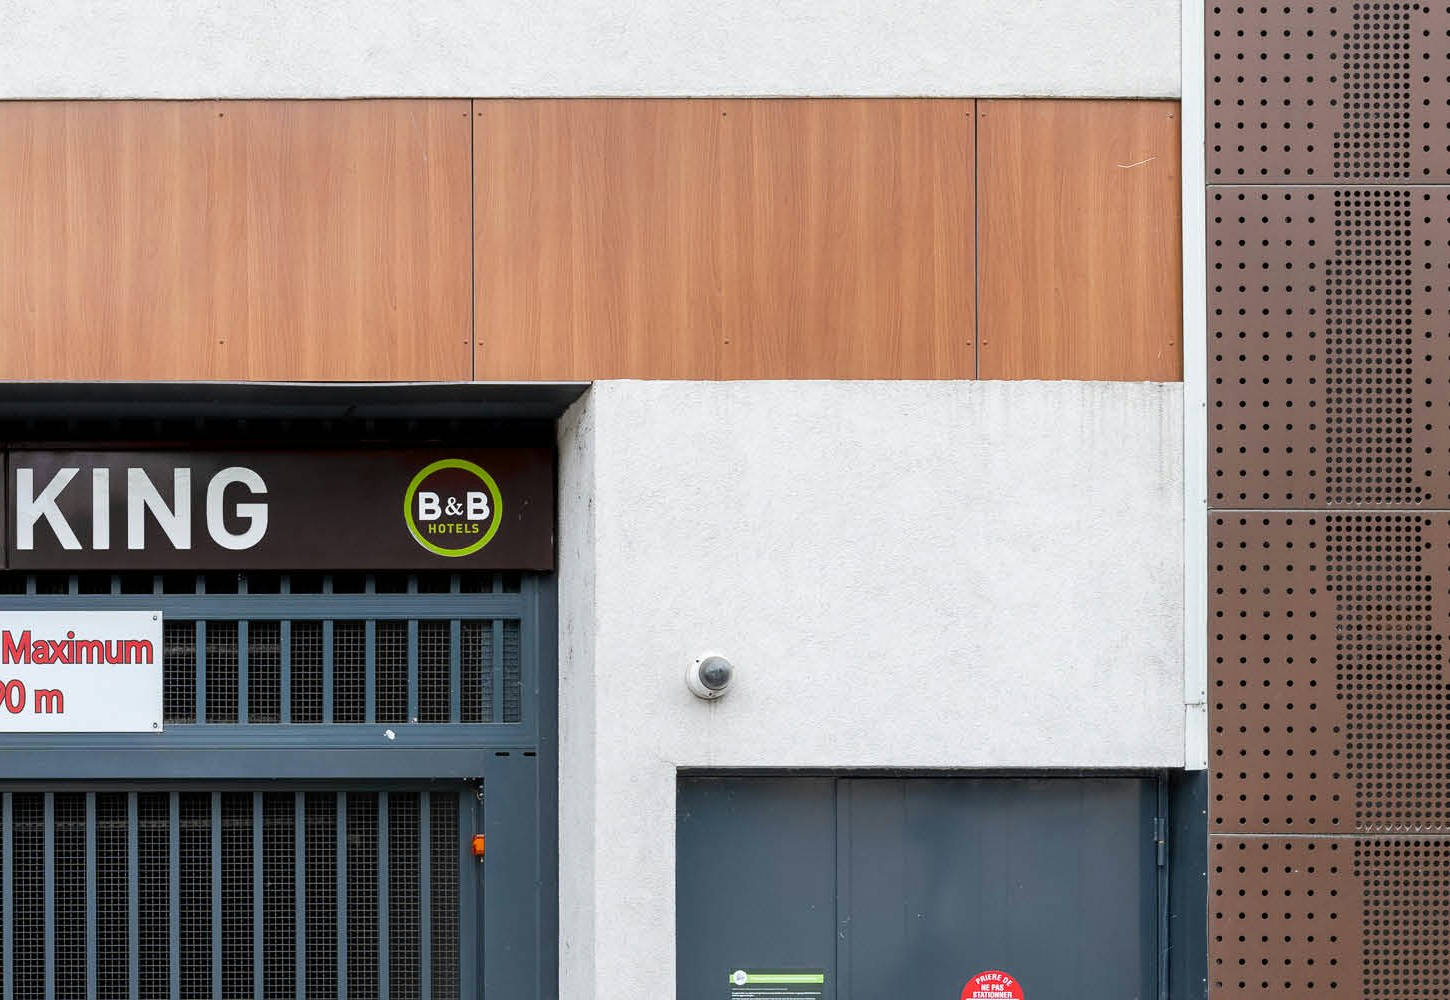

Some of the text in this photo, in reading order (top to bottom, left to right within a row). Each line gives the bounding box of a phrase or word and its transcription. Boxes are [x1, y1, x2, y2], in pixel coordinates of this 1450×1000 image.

[418, 491, 490, 521] B&B
[428, 523, 480, 534] HOTELS
[1, 630, 154, 665] Maximum
[34, 688, 64, 714] m
[981, 983, 1004, 991] NE PAS
[1002, 976, 1013, 987] DE
[972, 991, 1013, 999] STATIONNER
